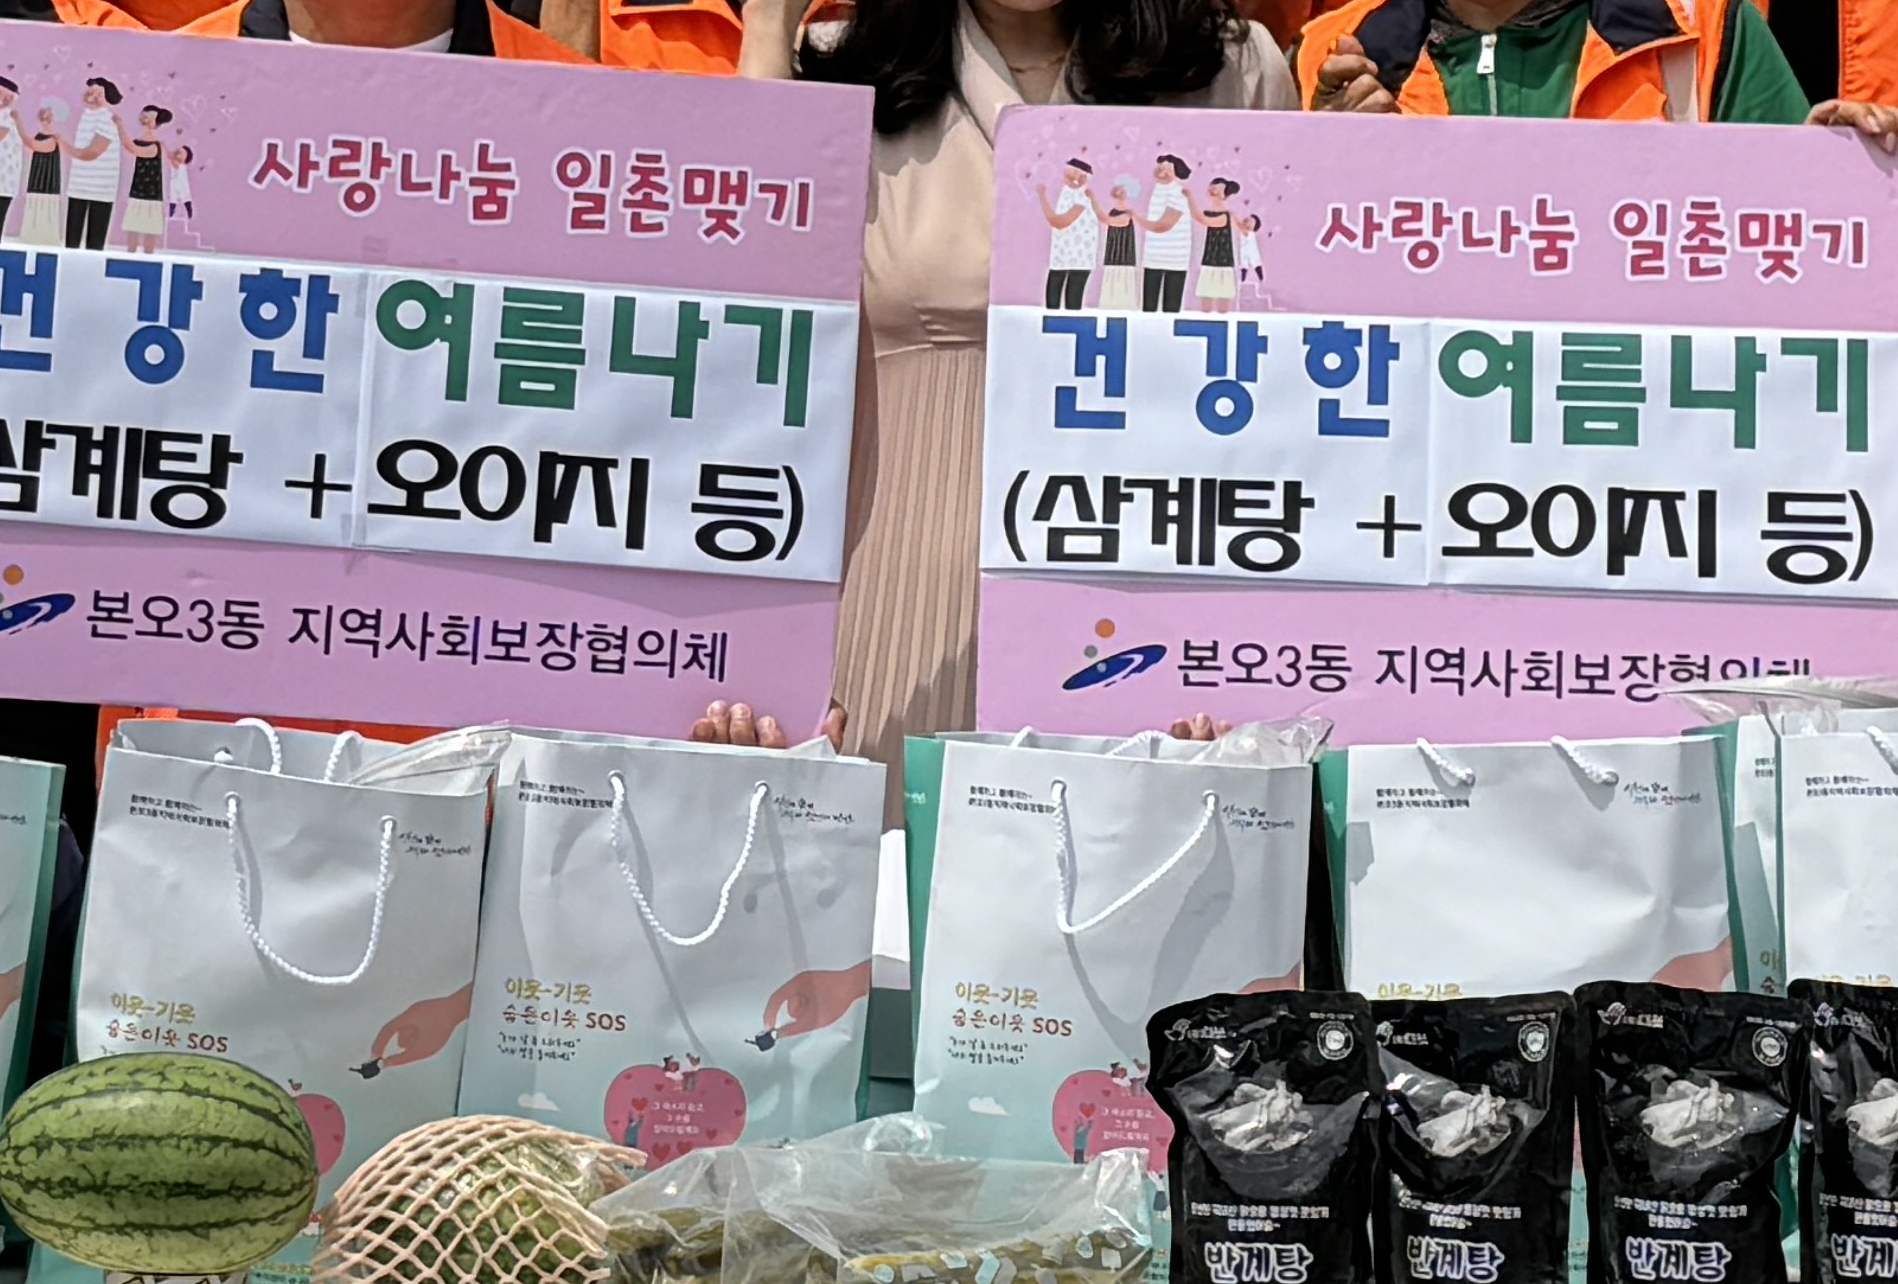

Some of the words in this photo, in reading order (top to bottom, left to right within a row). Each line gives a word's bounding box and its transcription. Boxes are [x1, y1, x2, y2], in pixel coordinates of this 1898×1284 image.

[253, 136, 519, 225] 사랑나눔
[552, 147, 814, 243] 일촌맺기
[1317, 196, 1578, 275] 사랑나눔
[1612, 199, 1868, 282] 일촌맺기
[375, 278, 815, 428] 여름나기
[1437, 329, 1870, 454] 여름나기
[690, 461, 806, 563] 등)
[1003, 470, 1316, 575] (삼계탕
[1759, 487, 1875, 584] 등)
[86, 588, 266, 652] 본오3동
[287, 606, 729, 683] 지역사회보장협의체
[1176, 639, 1353, 692] 본오3동
[186, 1032, 229, 1054] SOS
[585, 1012, 627, 1033] SOS
[1032, 1017, 1073, 1037] SOS
[1204, 1241, 1315, 1284] 반계탕
[1407, 1235, 1506, 1284] 반계탕
[1625, 1235, 1733, 1283] 반계탕
